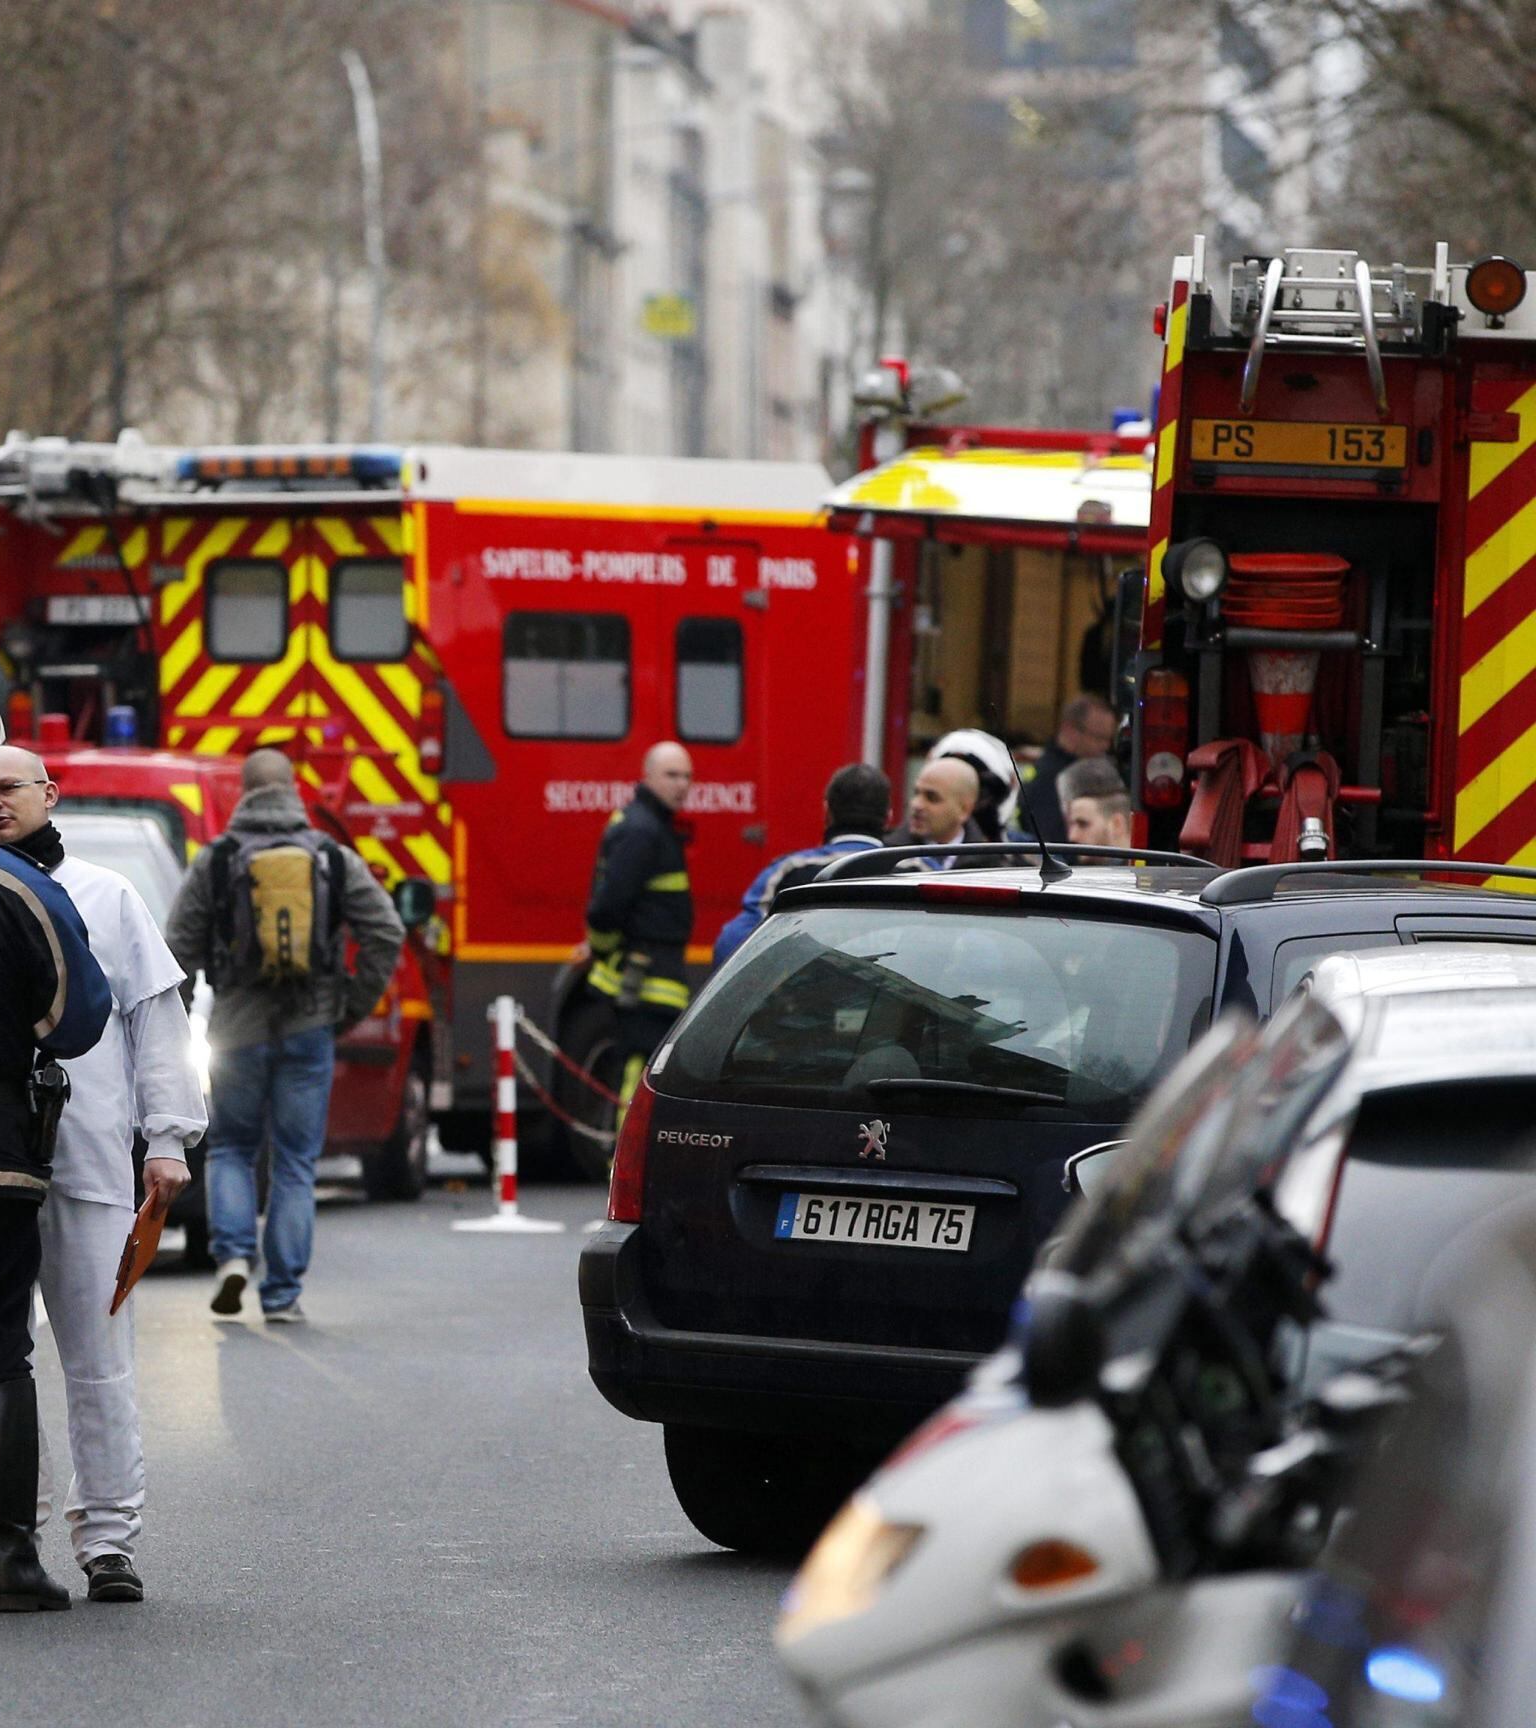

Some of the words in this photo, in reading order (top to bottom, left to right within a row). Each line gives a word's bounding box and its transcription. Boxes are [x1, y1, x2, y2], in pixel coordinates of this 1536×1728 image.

[1212, 424, 1255, 458] PS
[1328, 428, 1386, 463] 153
[707, 554, 737, 587] DE
[758, 556, 817, 590] PARIS
[657, 1130, 734, 1148] PEUGEOT
[780, 1219, 789, 1230] F
